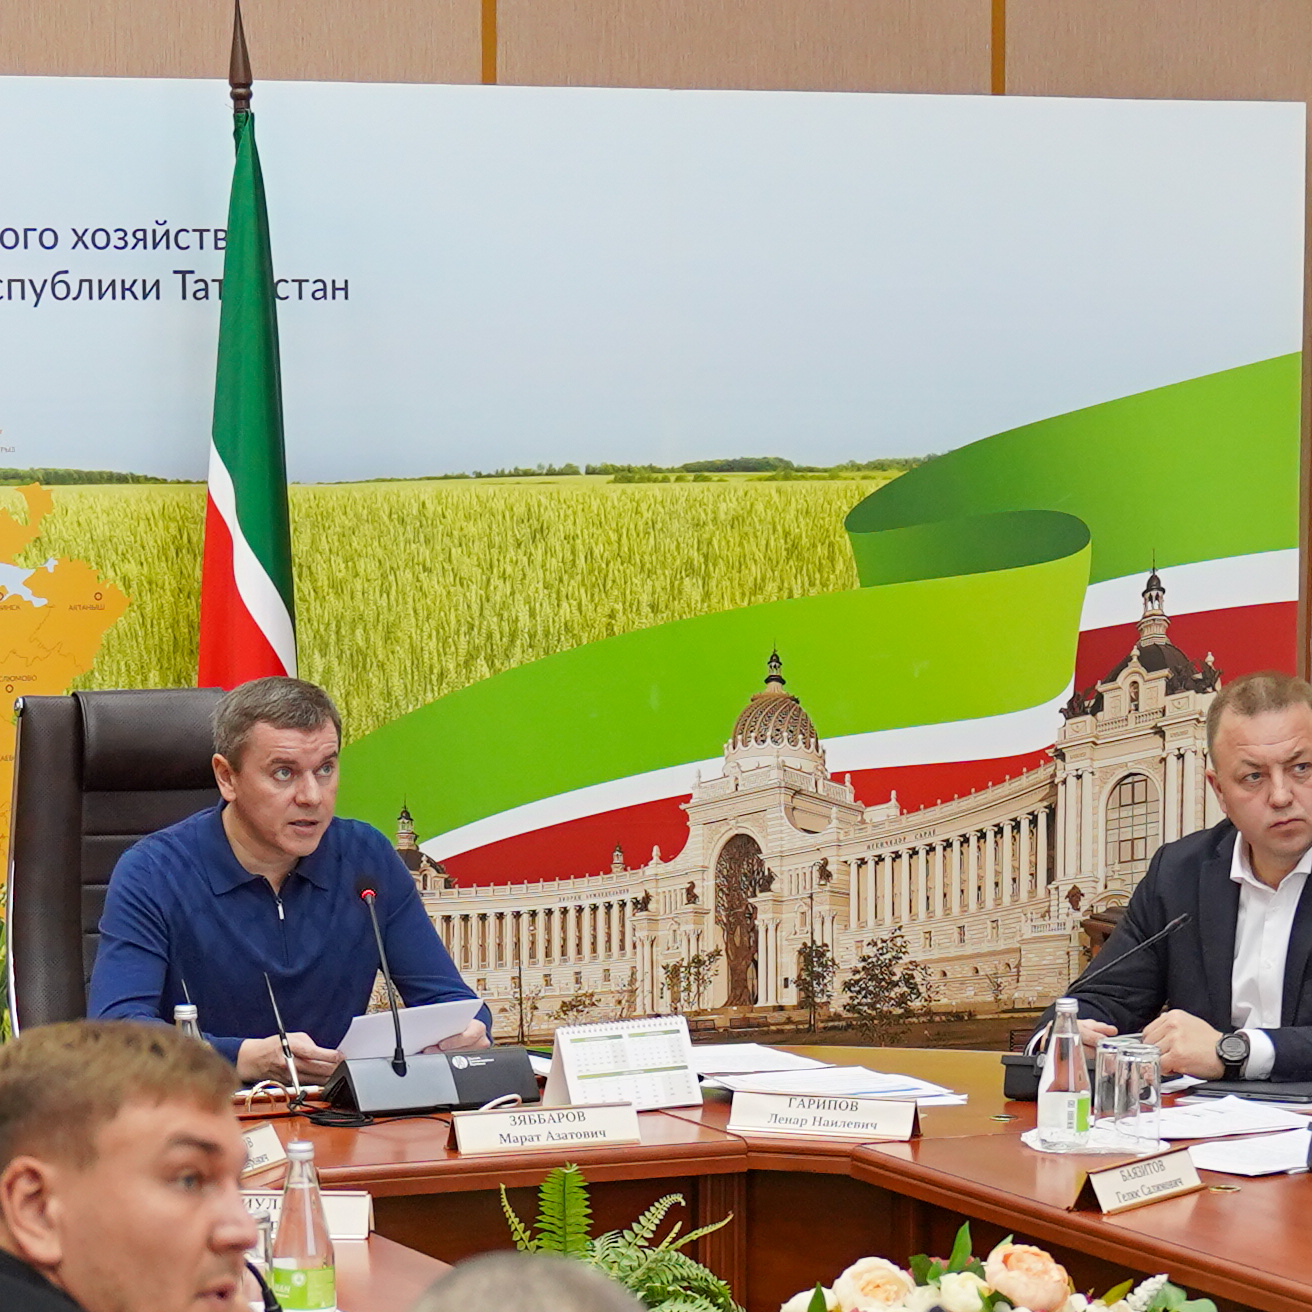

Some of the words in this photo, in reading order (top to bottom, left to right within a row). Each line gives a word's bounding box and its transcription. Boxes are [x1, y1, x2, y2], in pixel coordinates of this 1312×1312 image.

[71, 219, 229, 251] хозяйств
[172, 268, 350, 301] Татстан
[787, 1096, 859, 1112] ГАРИПОВ
[509, 1110, 587, 1127] ЗЯББАРОВ
[767, 1113, 808, 1128] Ленар
[812, 1115, 878, 1131] Наилевич
[498, 1133, 542, 1146] Марат
[545, 1129, 607, 1142] Азатович
[1119, 1159, 1167, 1183] БАЯЗИТОВ
